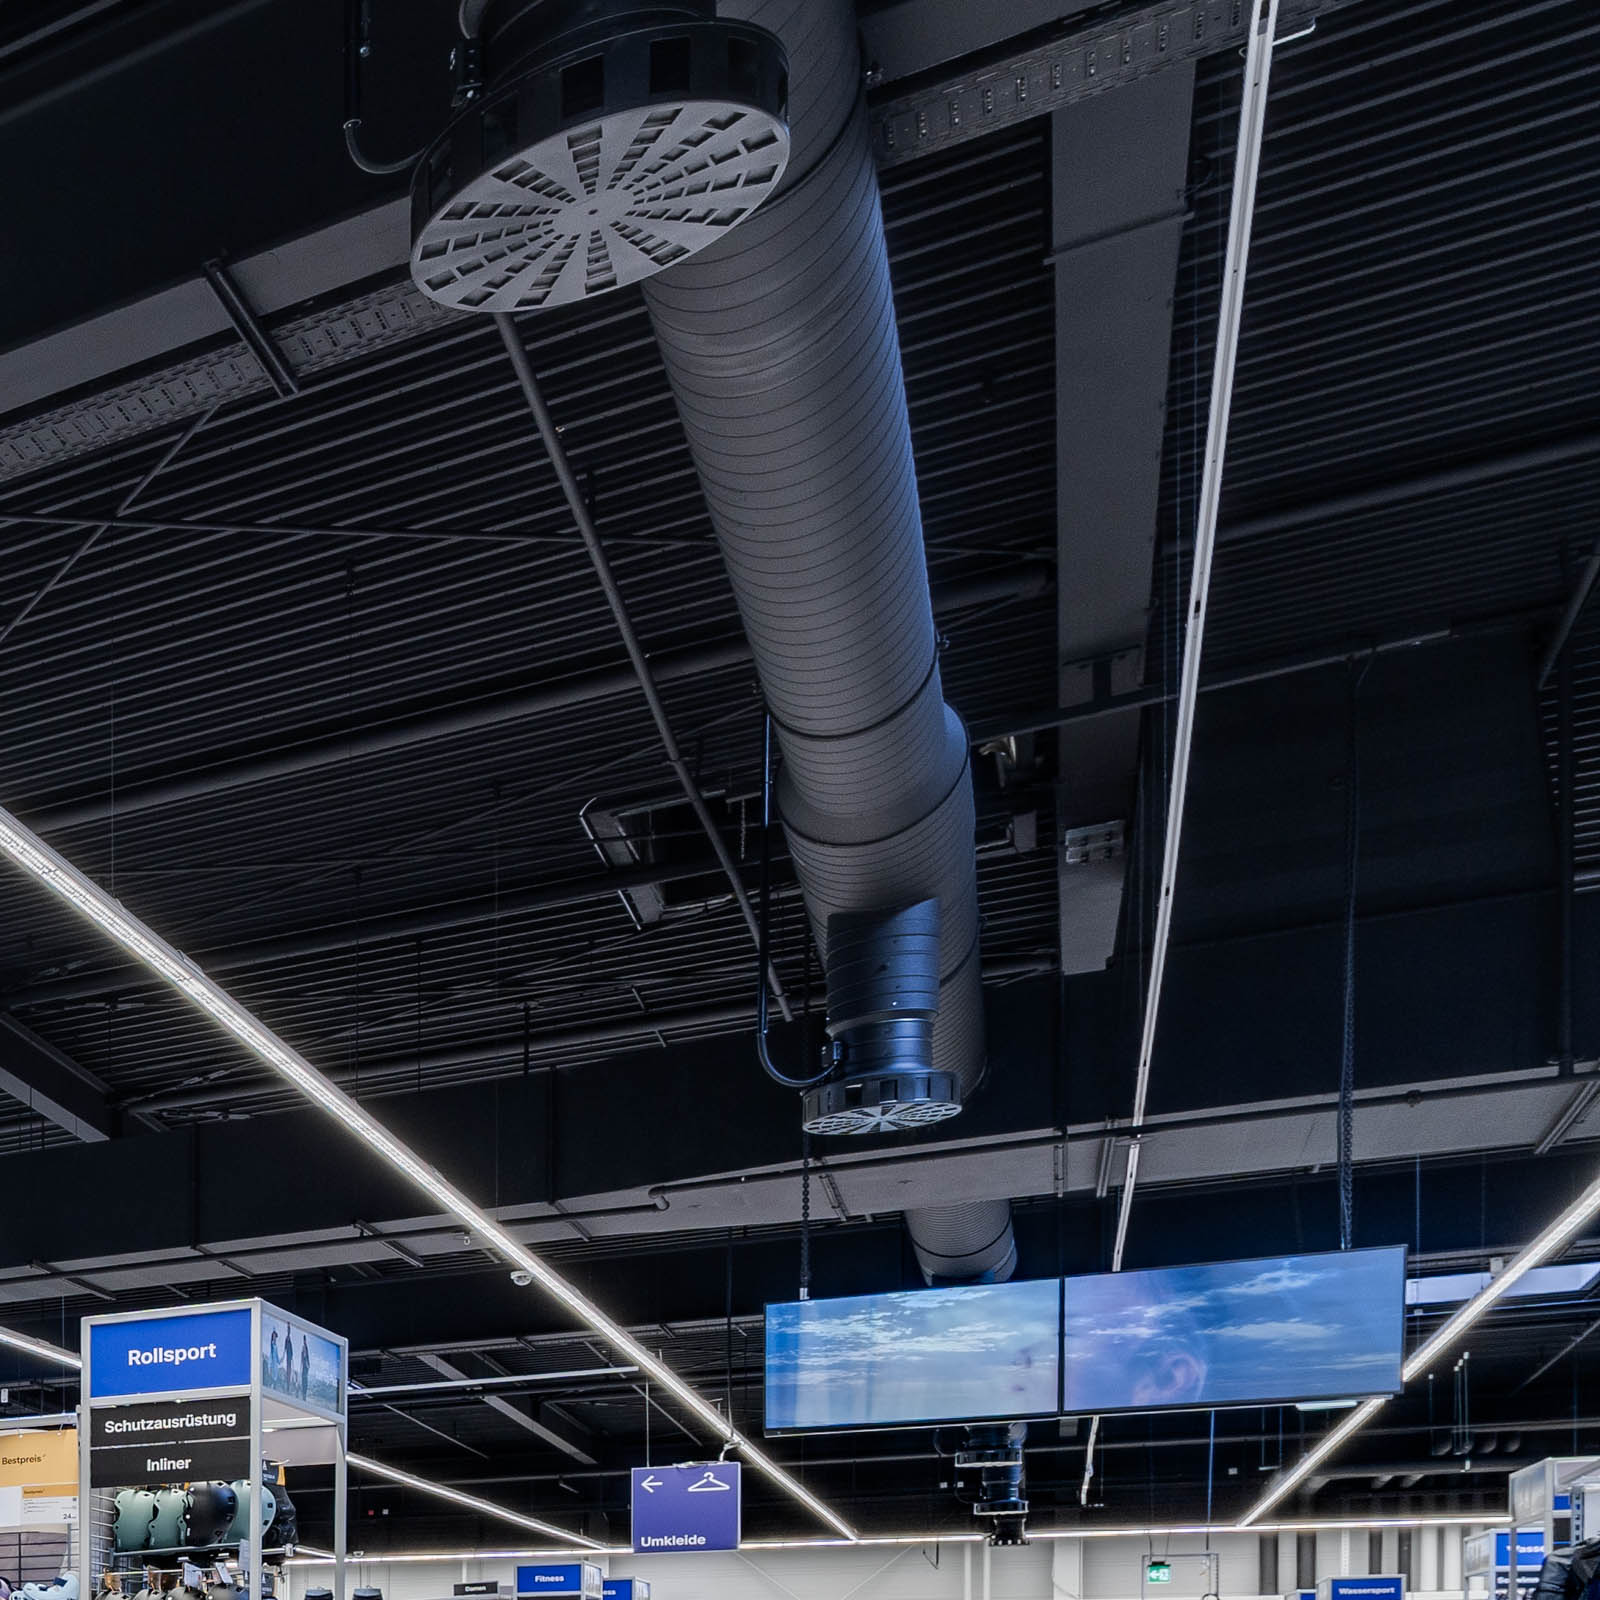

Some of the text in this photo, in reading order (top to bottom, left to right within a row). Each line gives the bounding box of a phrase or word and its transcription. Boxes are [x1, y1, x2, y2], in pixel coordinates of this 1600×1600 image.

[128, 1343, 217, 1366] Rollsport
[104, 1411, 237, 1434] Schutzausrüstung
[1, 1454, 42, 1466] Bestpreis
[146, 1457, 192, 1472] Inliner
[641, 1534, 706, 1547] Umkleide
[535, 1575, 564, 1583] Fitness
[1338, 1586, 1395, 1596] Wassersport
